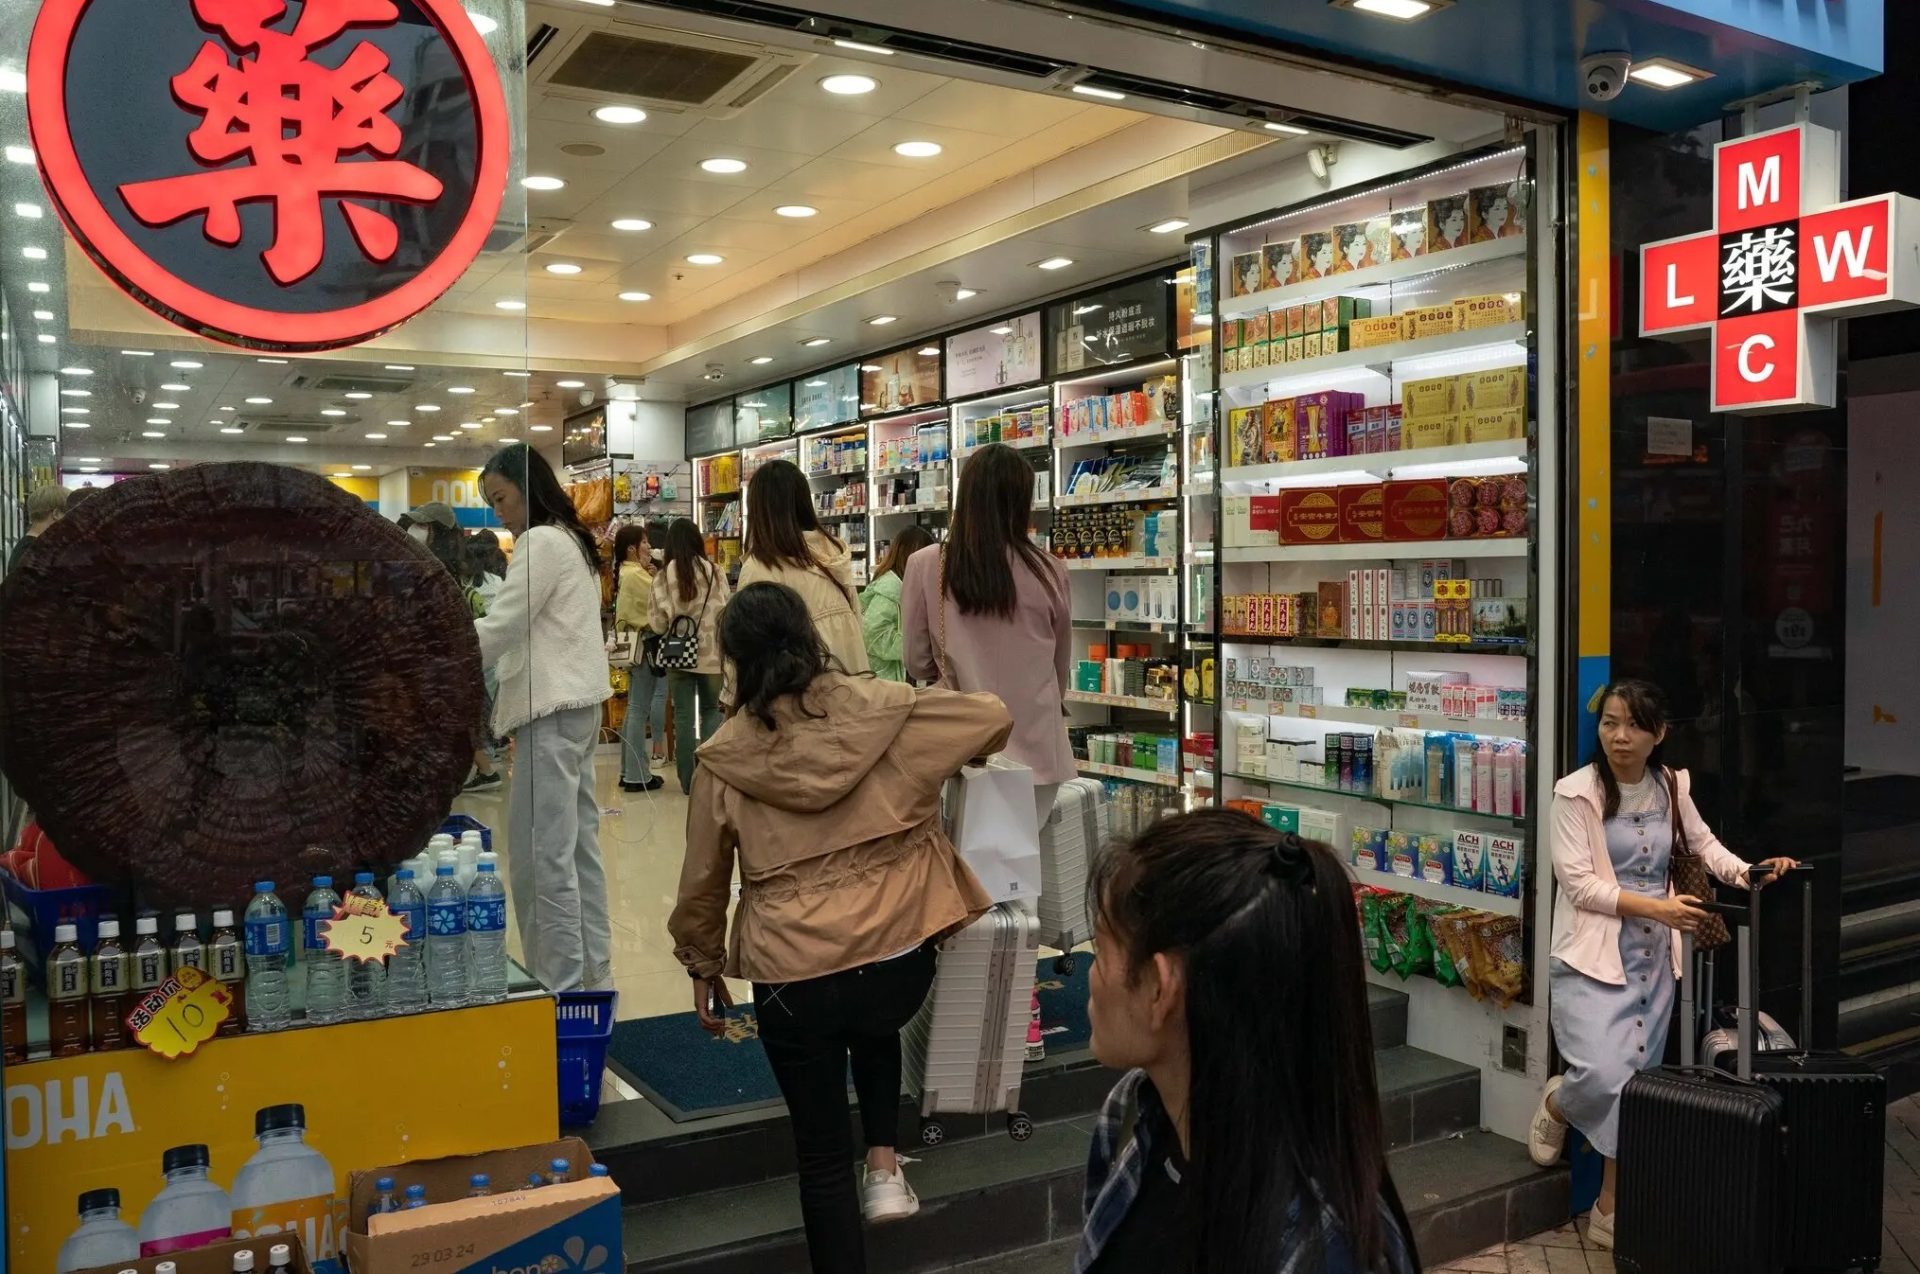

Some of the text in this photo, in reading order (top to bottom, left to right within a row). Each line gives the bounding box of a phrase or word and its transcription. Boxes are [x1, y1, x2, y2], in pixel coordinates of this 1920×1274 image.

[117, 0, 444, 287] 藥
[1737, 154, 1780, 210] M
[1721, 227, 1796, 316] 藥
[1812, 225, 1874, 283] W
[1666, 263, 1695, 309] L
[1737, 333, 1775, 383] C
[1458, 833, 1479, 845] ACH
[1492, 839, 1515, 851] ACH
[359, 925, 375, 945] 5
[166, 1003, 205, 1043] 10
[411, 1243, 476, 1268] 29 03 24
